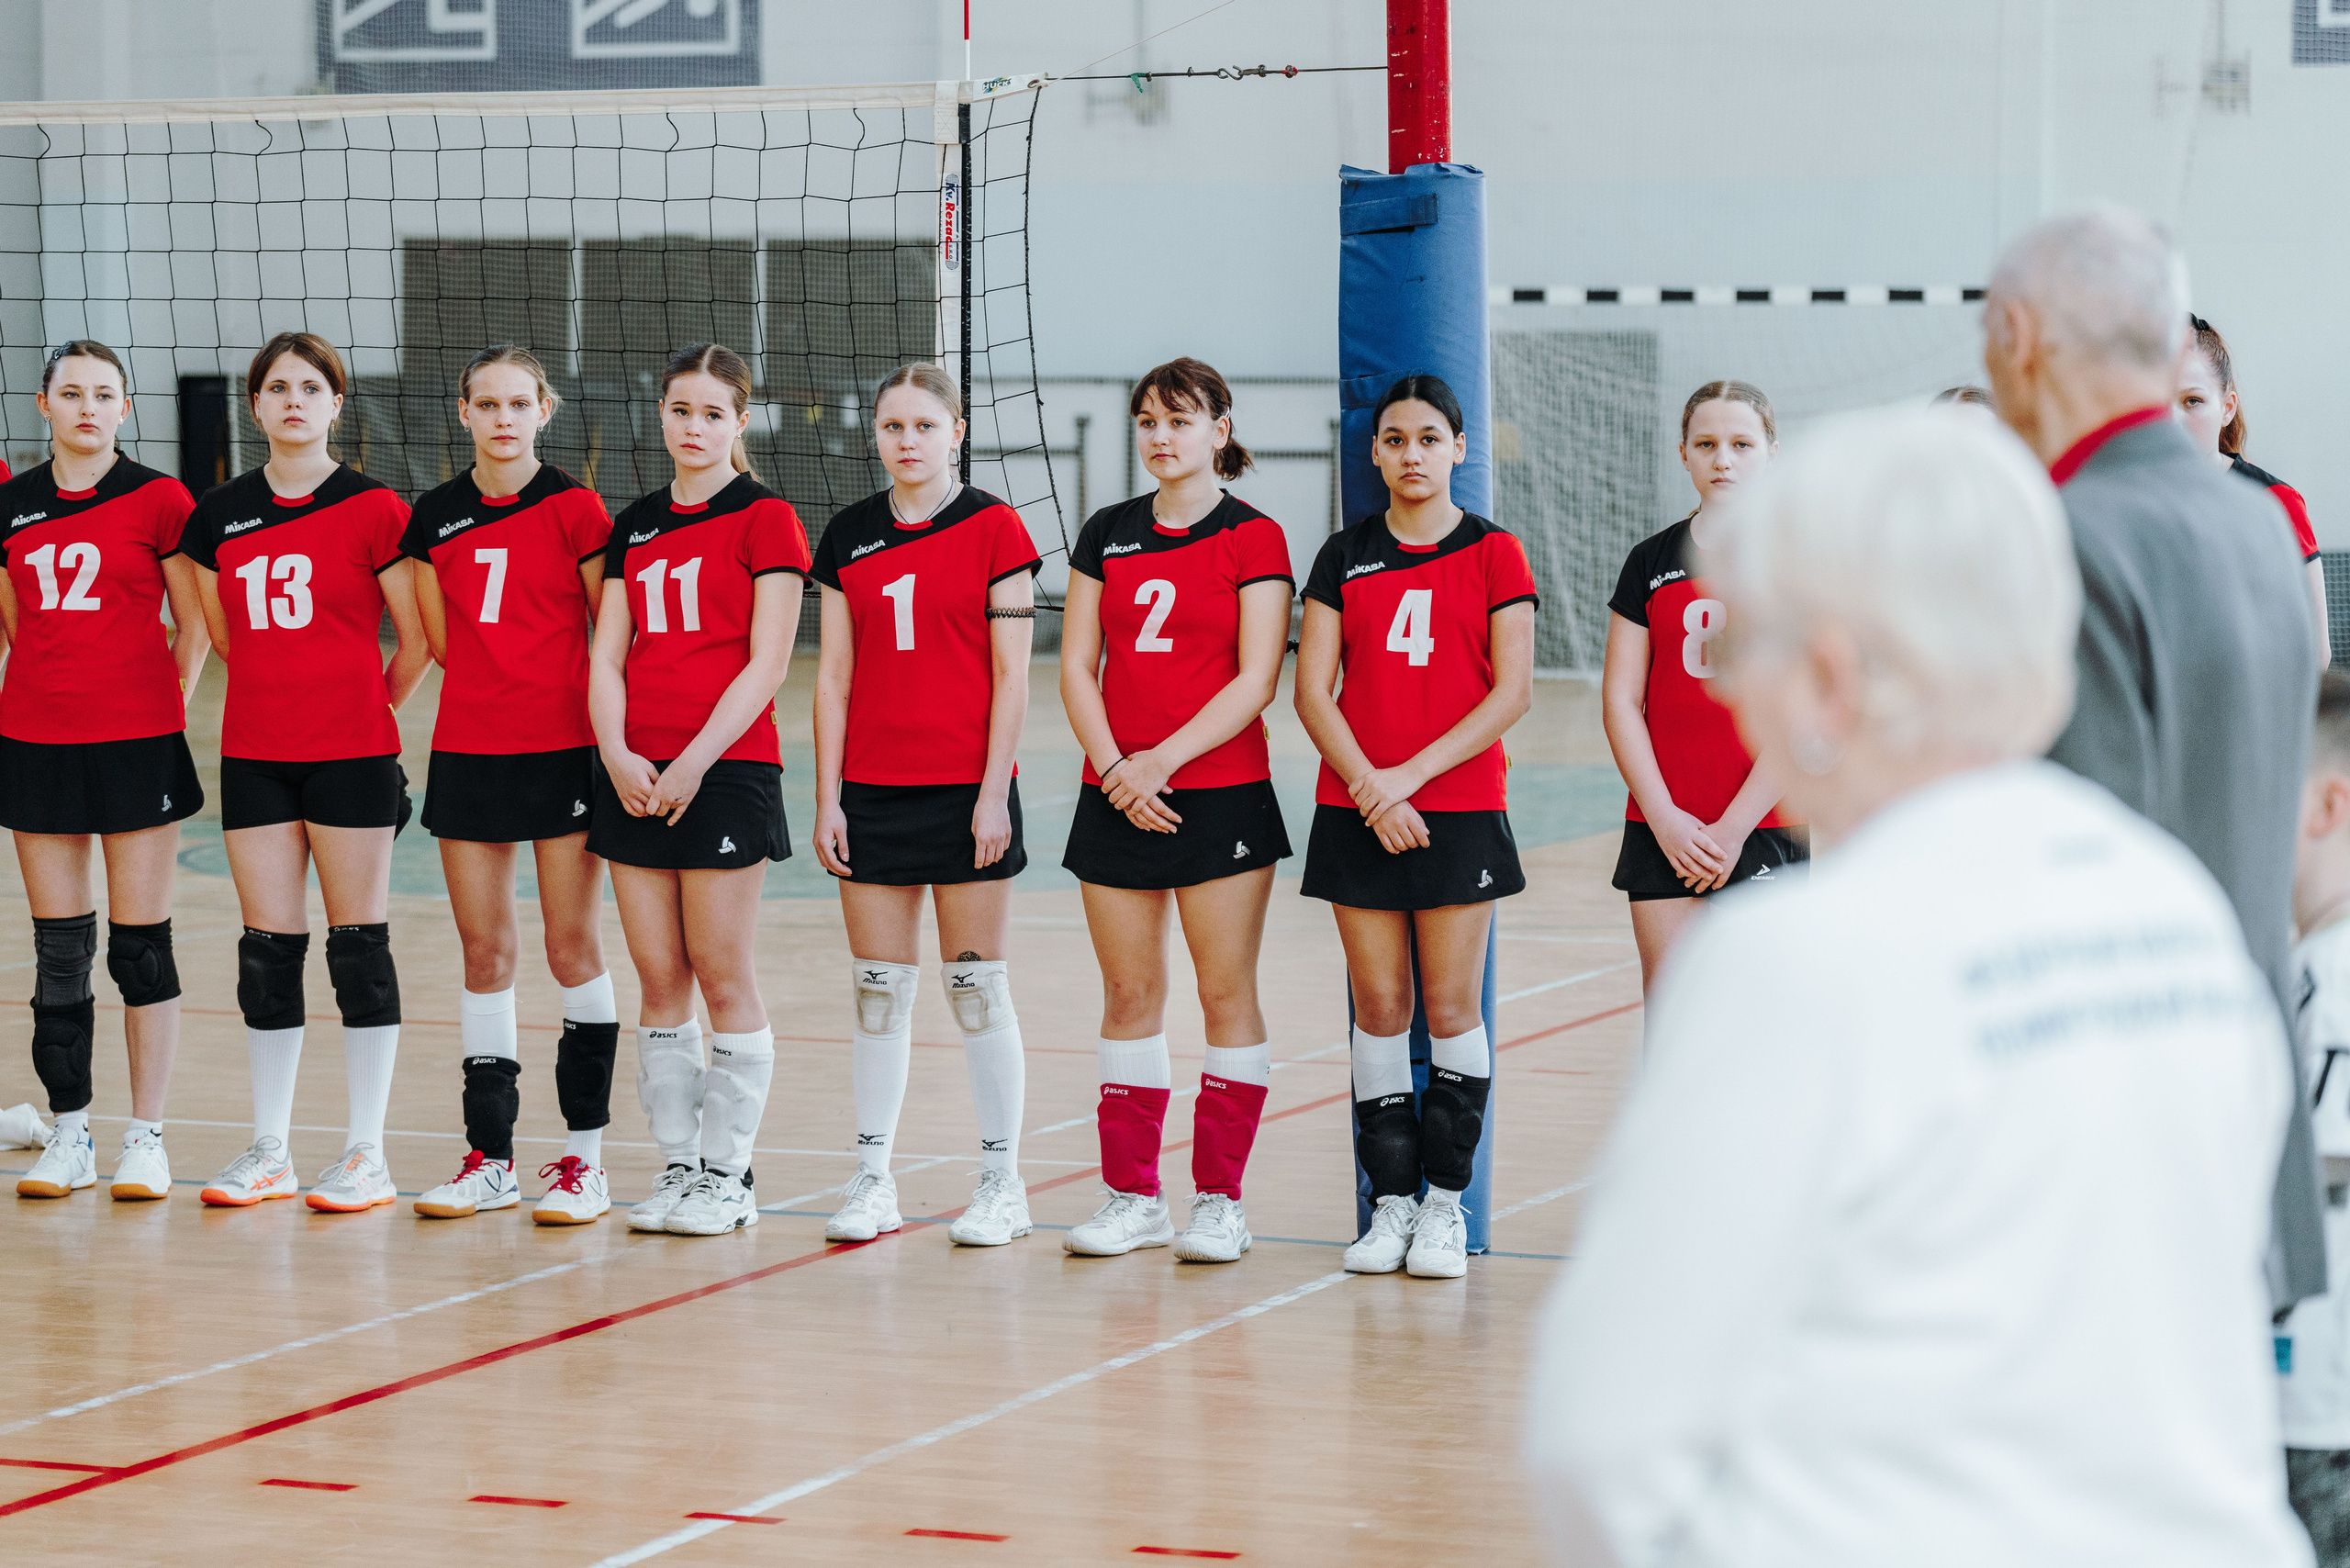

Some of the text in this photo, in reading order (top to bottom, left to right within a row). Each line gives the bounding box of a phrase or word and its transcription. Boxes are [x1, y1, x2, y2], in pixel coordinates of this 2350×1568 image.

[24, 542, 102, 610] 12
[236, 554, 314, 630] 13
[475, 548, 509, 623] 7
[636, 556, 703, 633] 11
[882, 574, 916, 651] 1
[1135, 579, 1177, 653] 2
[1386, 588, 1435, 666] 4
[1682, 599, 1728, 679] 8
